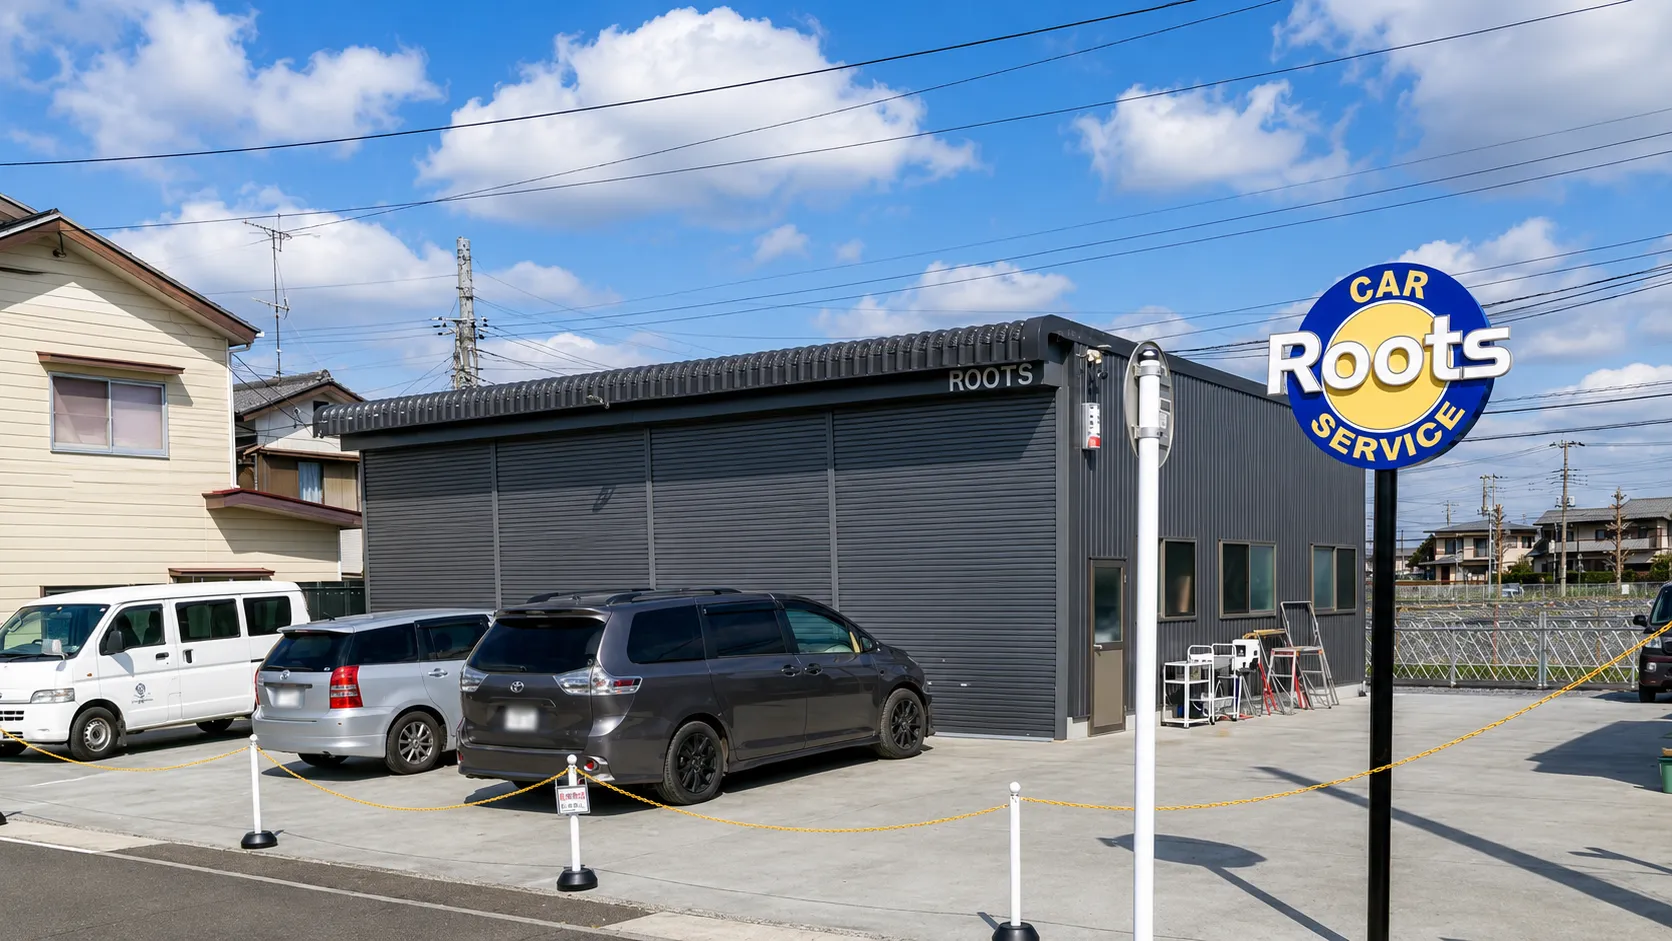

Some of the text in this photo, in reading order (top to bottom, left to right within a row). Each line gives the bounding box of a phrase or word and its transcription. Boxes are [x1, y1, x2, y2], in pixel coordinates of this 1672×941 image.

[1350, 269, 1429, 303] CAR
[949, 363, 1033, 392] ROOTS
[1267, 314, 1513, 396] Roots
[1311, 401, 1466, 462] SERVICE
